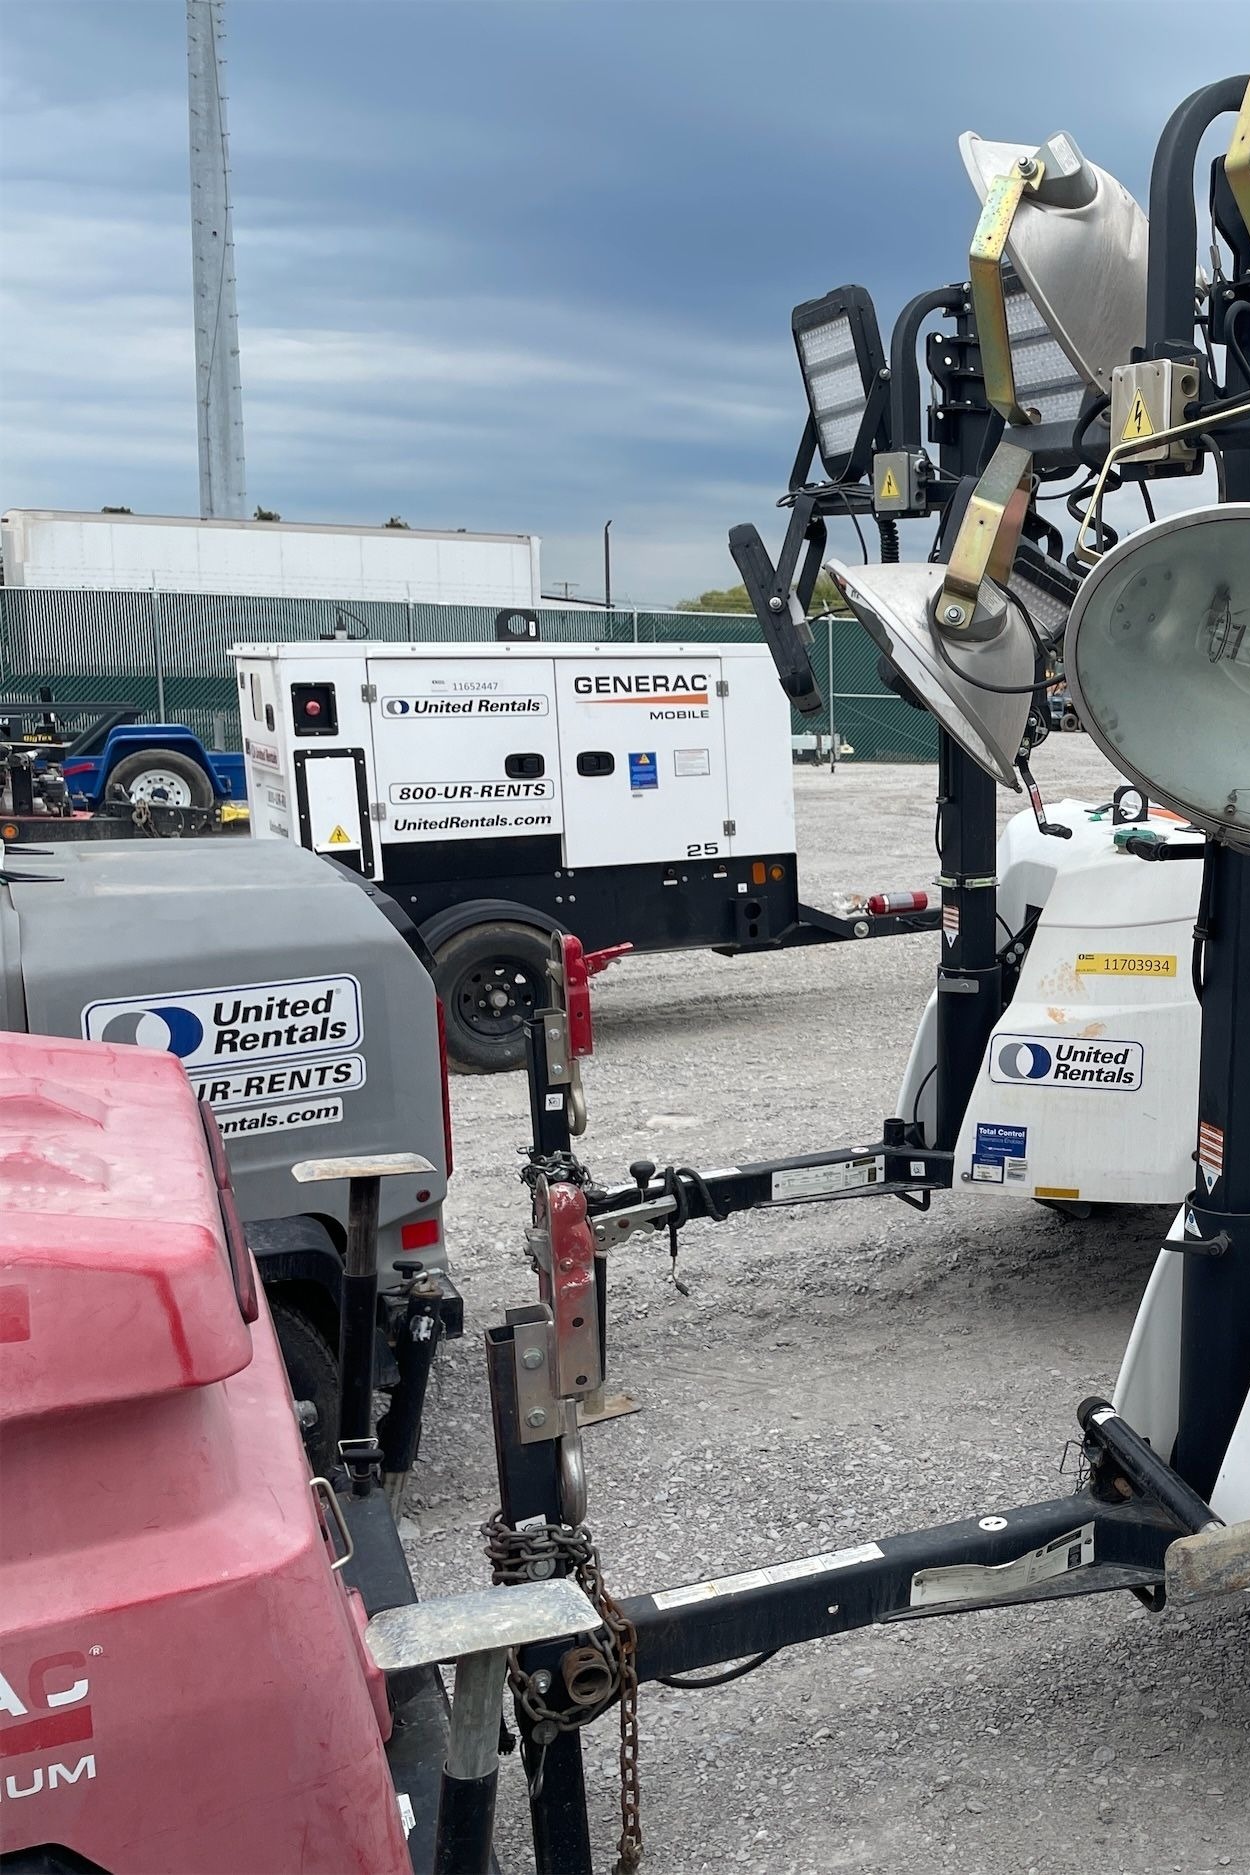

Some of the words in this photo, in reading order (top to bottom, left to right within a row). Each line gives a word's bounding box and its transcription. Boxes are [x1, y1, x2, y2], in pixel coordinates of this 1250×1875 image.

[453, 682, 498, 691] 11652447
[574, 674, 709, 694] GENERAC
[414, 700, 472, 714] United
[477, 699, 540, 713] Rentals
[649, 710, 710, 720] MOBILE
[399, 783, 546, 800] 800-UR-RENTS
[393, 815, 552, 831] UnitedRentals.com
[687, 843, 719, 857] 25
[1103, 958, 1170, 973] 11703934
[213, 989, 334, 1027] United
[214, 1017, 347, 1055] Rentals
[1055, 1044, 1130, 1065] United
[1053, 1063, 1135, 1084] Rentals
[978, 1127, 997, 1136] Total
[997, 1128, 1026, 1138] Control
[0, 1754, 97, 1801] UM
